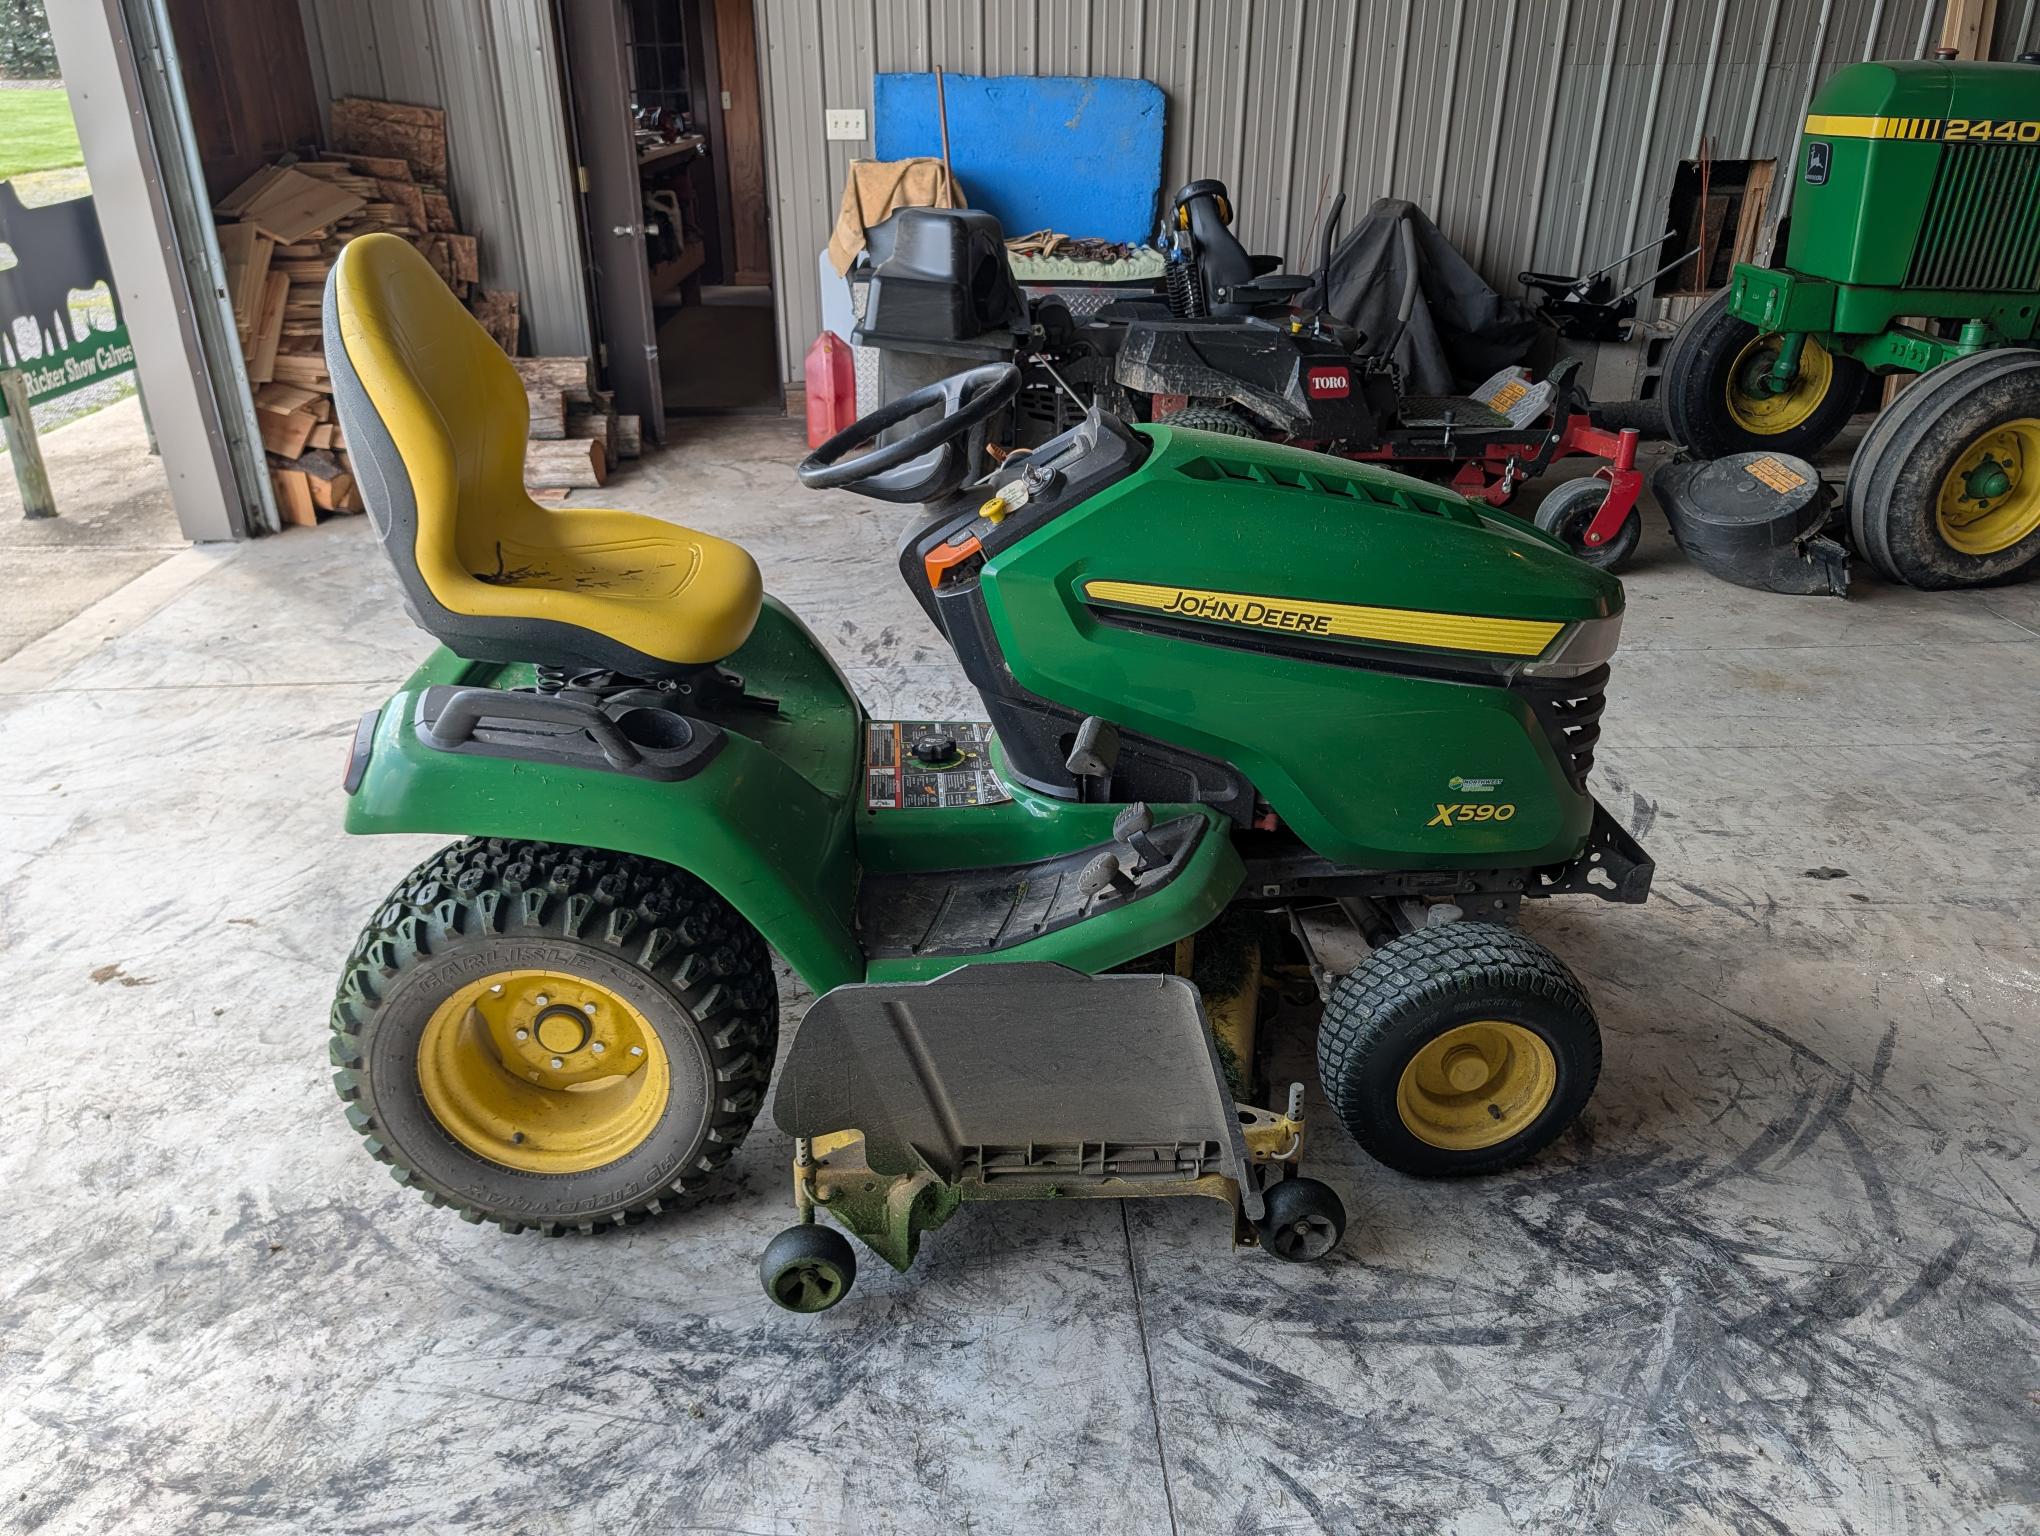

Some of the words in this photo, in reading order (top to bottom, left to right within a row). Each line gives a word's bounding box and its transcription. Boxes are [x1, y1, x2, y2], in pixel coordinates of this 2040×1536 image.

[1944, 119, 2040, 142] 2440
[22, 366, 67, 398] Ricker
[64, 357, 97, 382] Show
[96, 344, 134, 370] Calves
[1312, 376, 1346, 390] TORO
[1163, 591, 1239, 620] JOHN
[1241, 602, 1333, 632] DEERE
[1426, 803, 1516, 826] X590
[418, 945, 597, 993] CARLISLE
